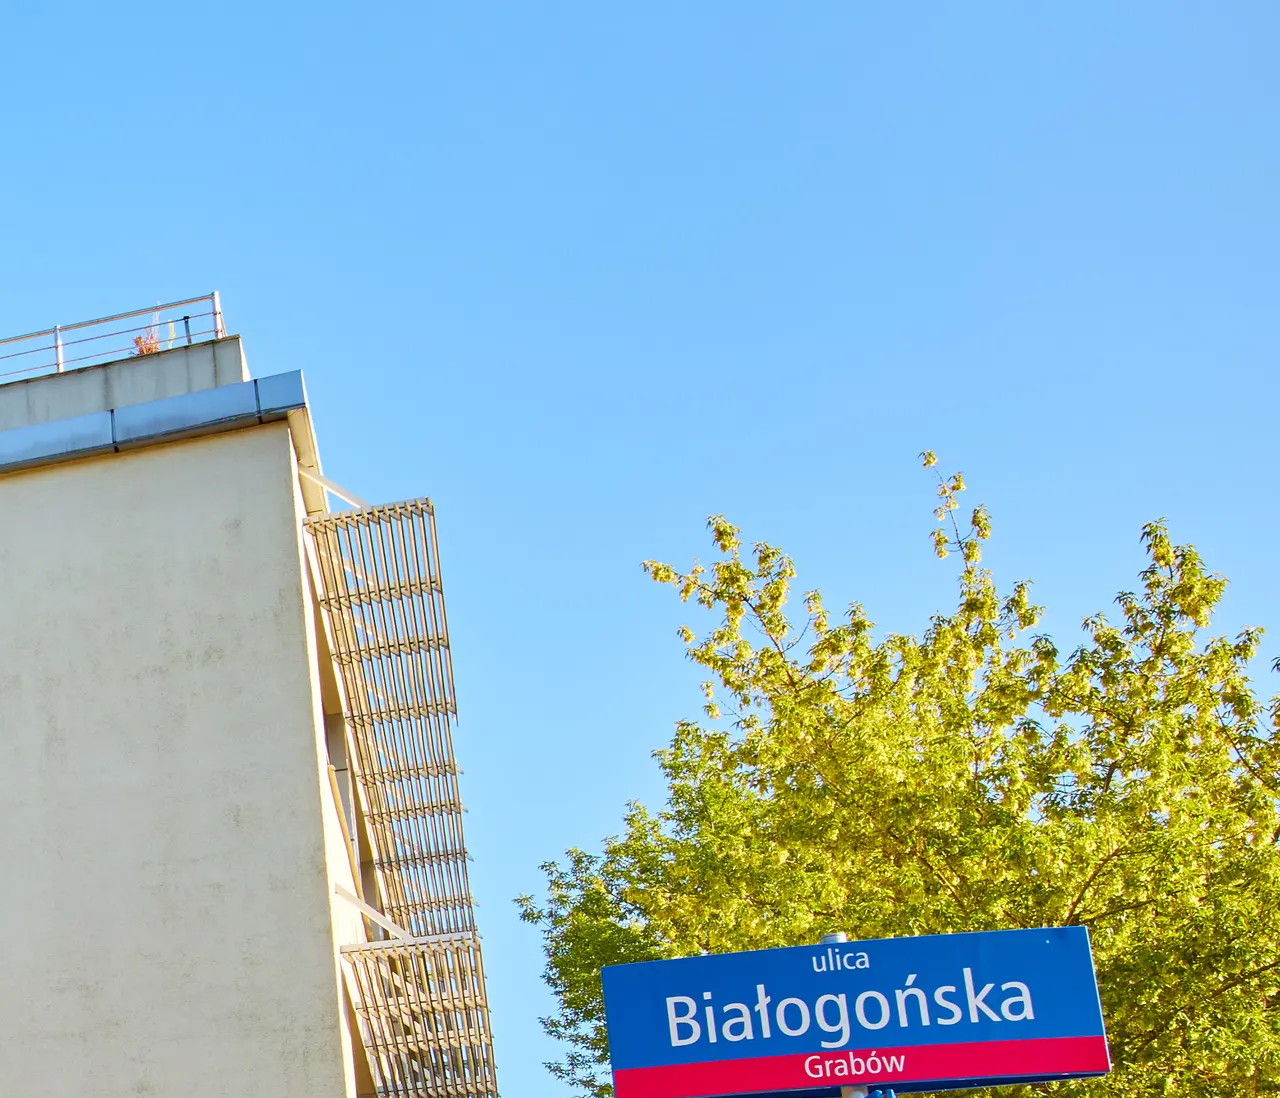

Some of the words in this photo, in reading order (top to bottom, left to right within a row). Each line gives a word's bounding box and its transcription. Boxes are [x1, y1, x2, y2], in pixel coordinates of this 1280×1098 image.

[811, 948, 871, 974] ulica
[665, 967, 1036, 1050] Białogońska
[803, 1050, 906, 1079] Grabów
